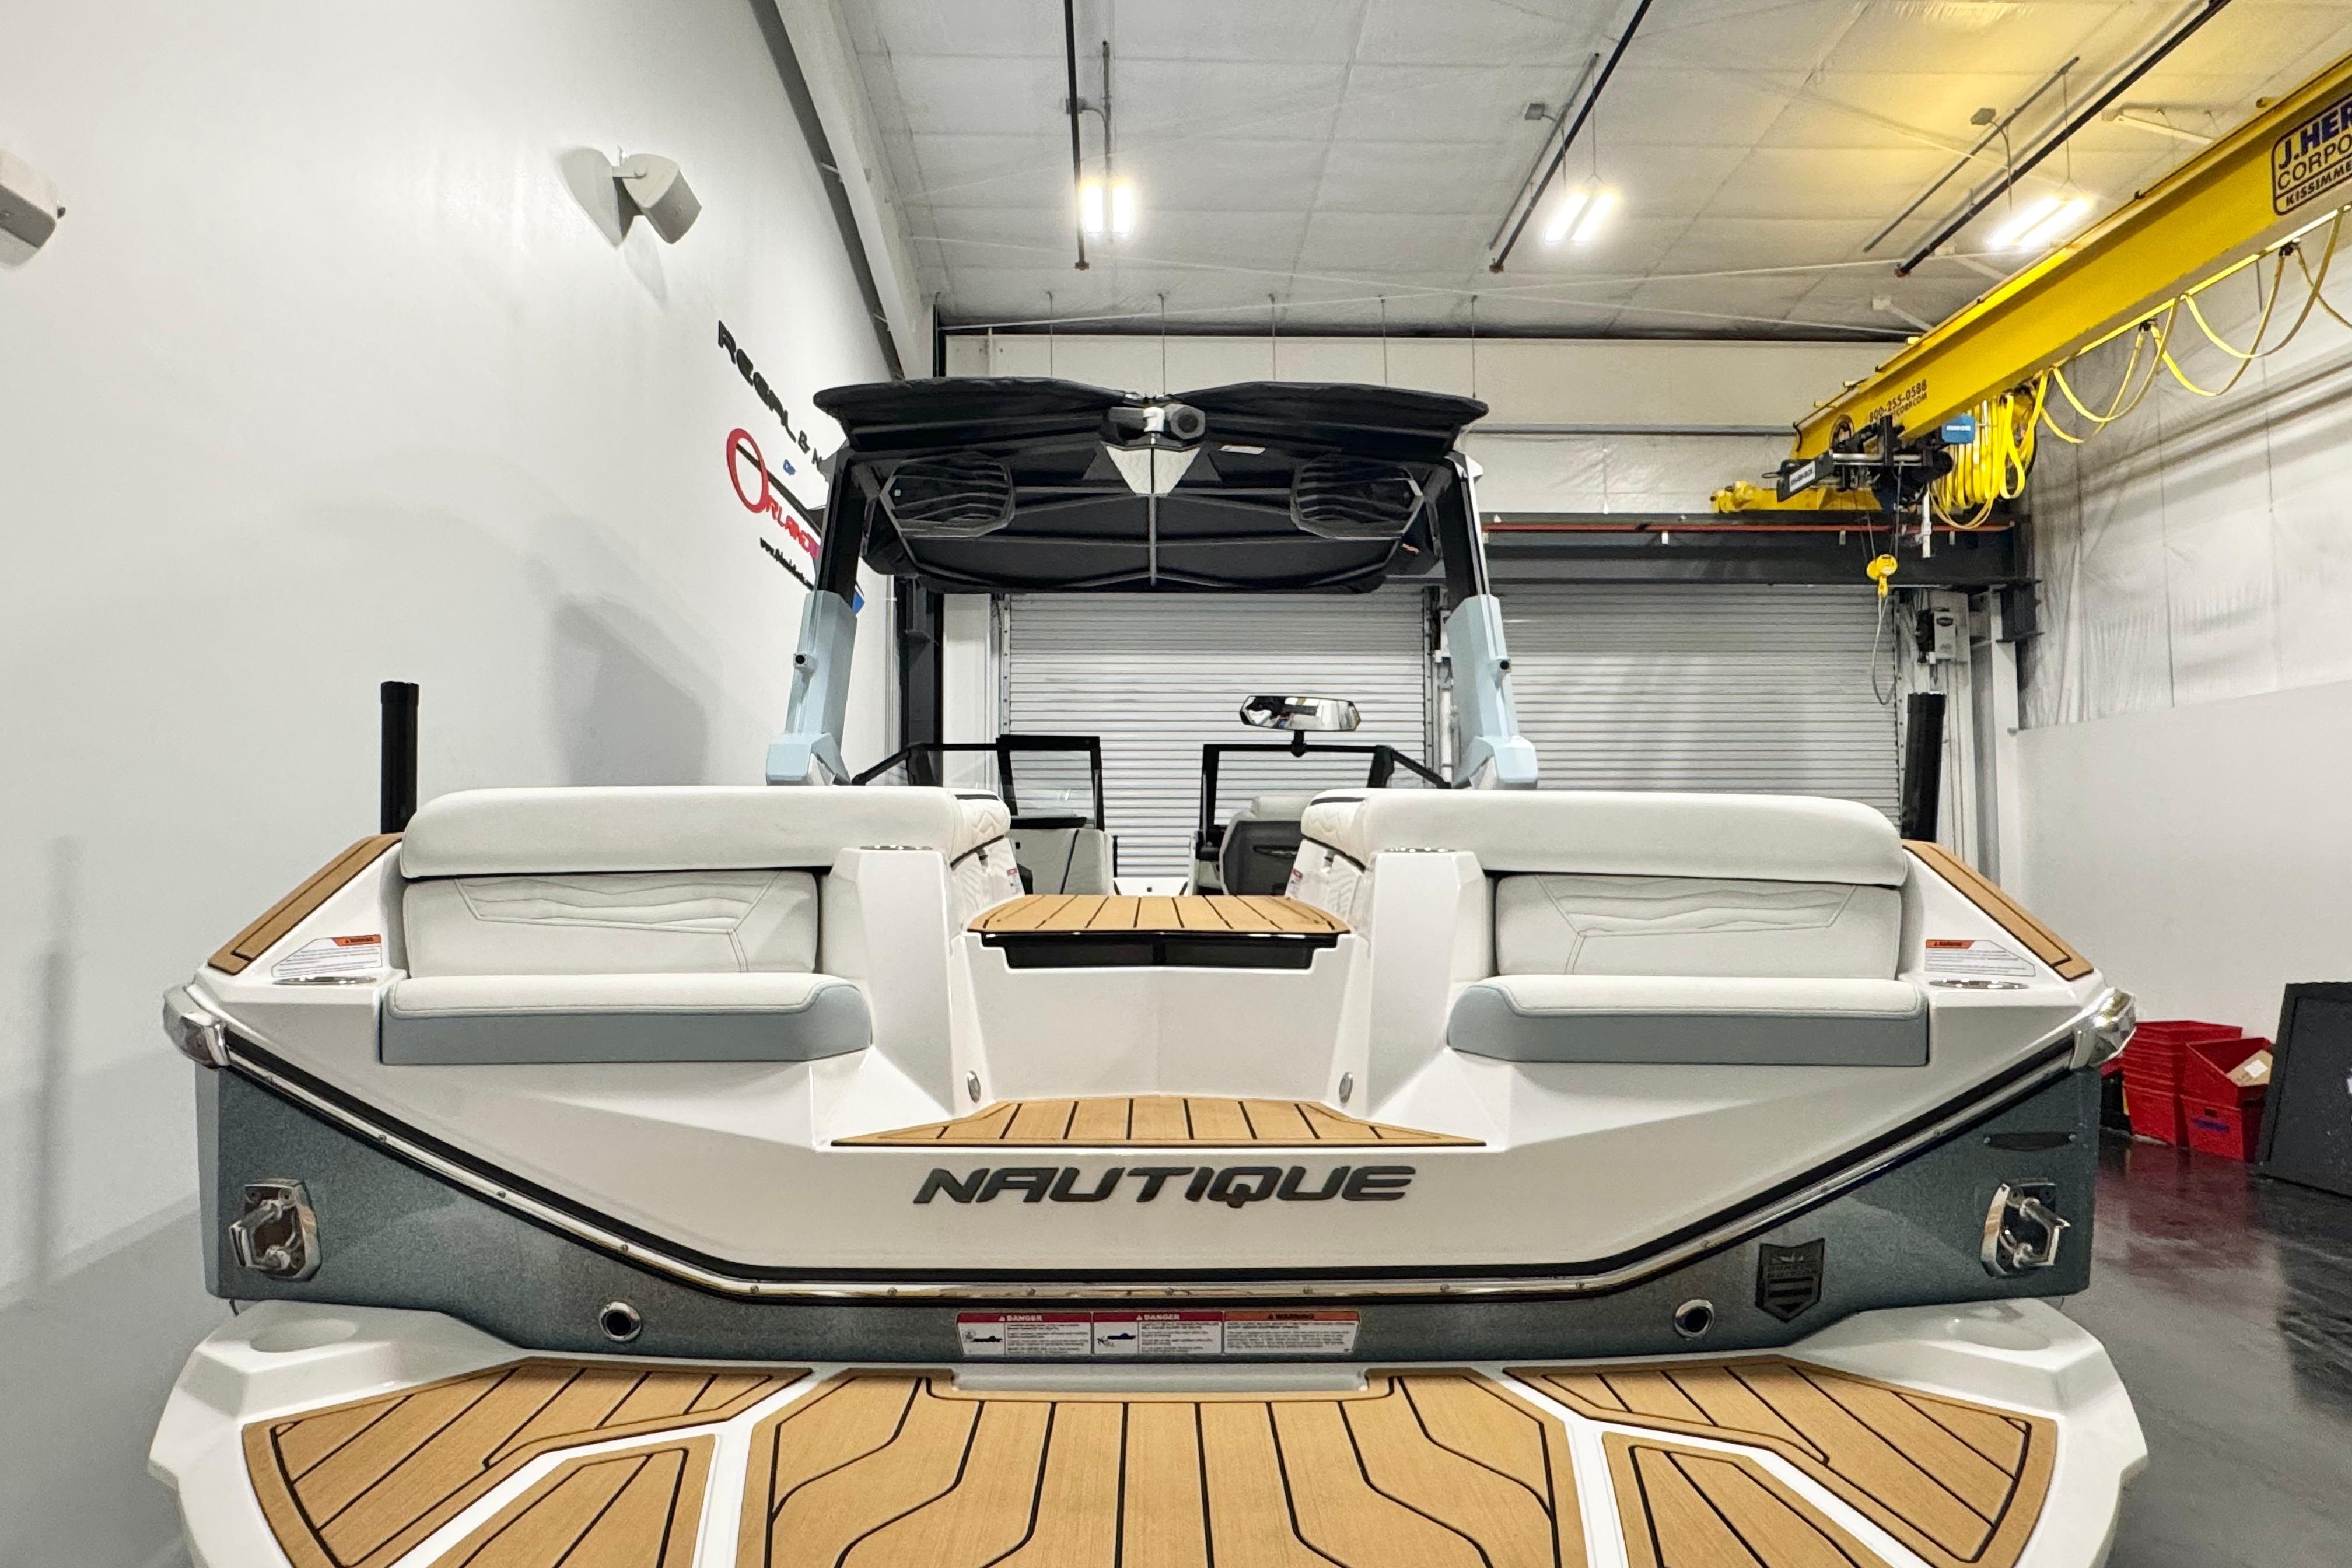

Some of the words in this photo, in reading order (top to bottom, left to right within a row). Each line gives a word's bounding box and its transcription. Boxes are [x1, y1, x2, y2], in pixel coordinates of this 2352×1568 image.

[2277, 134, 2352, 190] CORPO
[718, 320, 797, 443] REGAL
[798, 429, 811, 454] &
[913, 1166, 1416, 1208] NAUTIQUE
